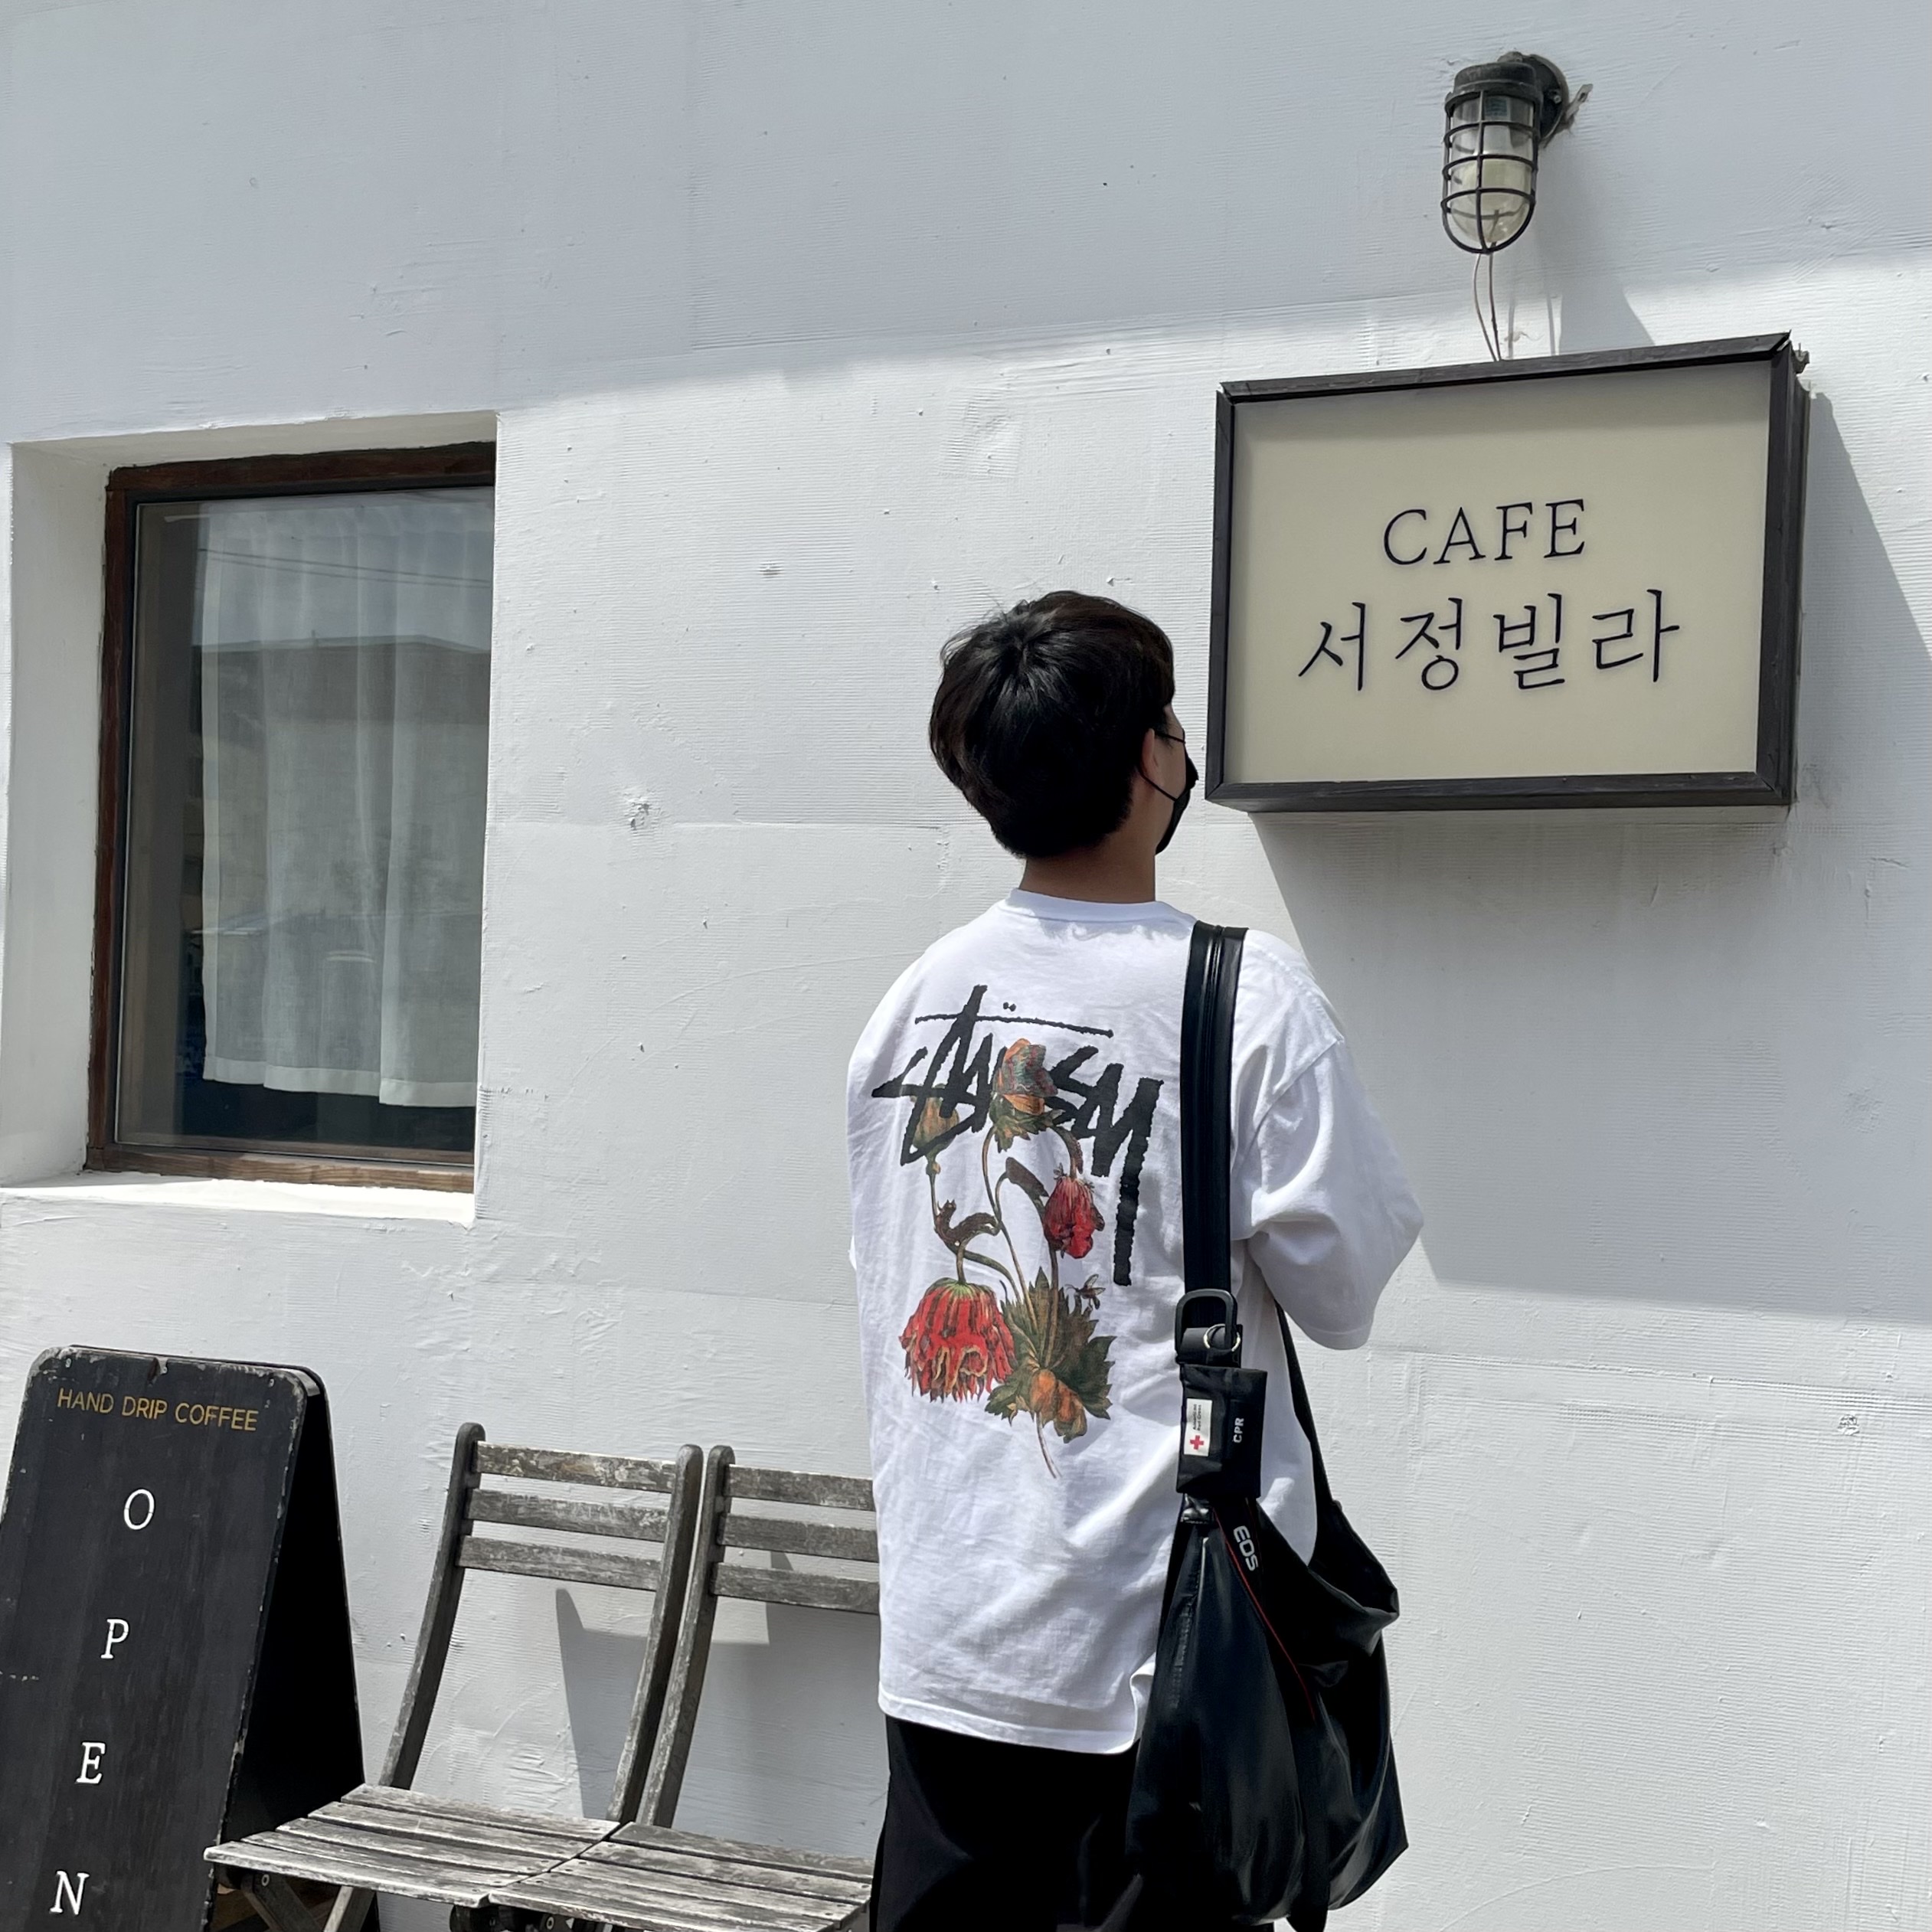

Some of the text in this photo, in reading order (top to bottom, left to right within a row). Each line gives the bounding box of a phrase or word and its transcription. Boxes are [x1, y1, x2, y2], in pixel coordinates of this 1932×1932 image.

[1383, 499, 1585, 565] CAFE
[1298, 589, 1680, 691] 서정빌라
[57, 1387, 260, 1432] HAND DRIP COFFEE
[1233, 1417, 1244, 1443] CPR
[1233, 1525, 1259, 1571] EOS
[50, 1488, 155, 1916] OPEN
